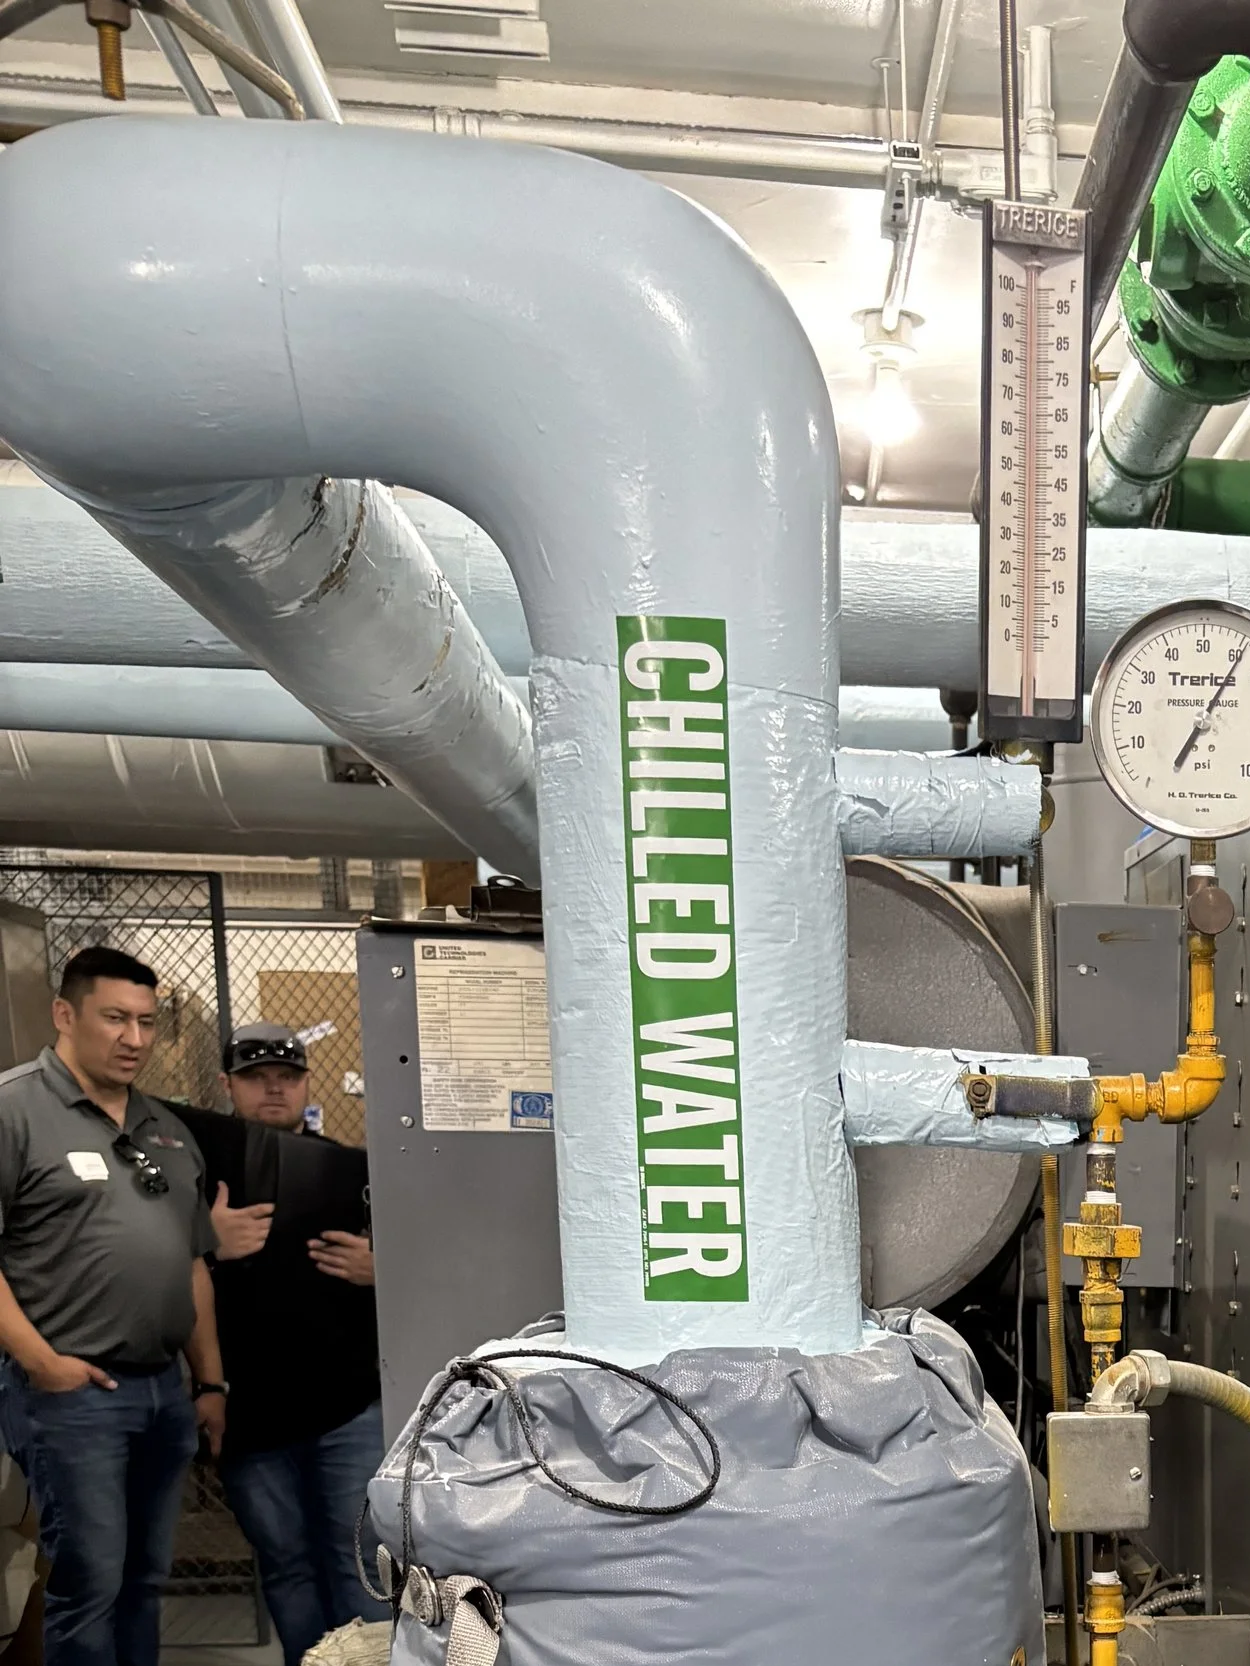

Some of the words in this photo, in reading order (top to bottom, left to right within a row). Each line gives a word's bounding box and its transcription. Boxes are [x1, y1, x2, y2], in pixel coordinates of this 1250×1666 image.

[999, 275, 1015, 291] 100
[1070, 280, 1077, 293] F
[1056, 300, 1070, 314] 95
[1002, 314, 1014, 329] 90
[1056, 337, 1070, 351] 85
[1002, 349, 1014, 364] 80
[1056, 373, 1069, 387] 75
[1002, 385, 1014, 400] 70
[1054, 409, 1069, 423] 65
[1001, 421, 1013, 435] 60
[1054, 445, 1068, 459] 55
[1001, 457, 1013, 471] 50
[1054, 478, 1067, 492] 45
[1000, 492, 1012, 506] 40
[1052, 513, 1067, 527] 35
[1000, 527, 1012, 541] 30
[1052, 547, 1066, 561] 25
[1000, 561, 1011, 575] 20
[1052, 581, 1065, 595] 15
[1000, 595, 1011, 608] 10
[1051, 615, 1059, 628] 5
[1004, 628, 1011, 642] 0
[1196, 639, 1210, 653] 50
[1164, 648, 1179, 661] 40
[1228, 649, 1242, 662] 60
[1141, 671, 1155, 685] 30
[1168, 672, 1236, 687] Trerice
[1128, 701, 1142, 714] 20
[1167, 699, 1205, 707] PRESSURE
[1209, 700, 1239, 708] AUGE
[1130, 735, 1145, 749] 10
[1194, 759, 1211, 771] psi
[624, 640, 731, 979] CHILLED
[639, 1012, 742, 1279] WATER
